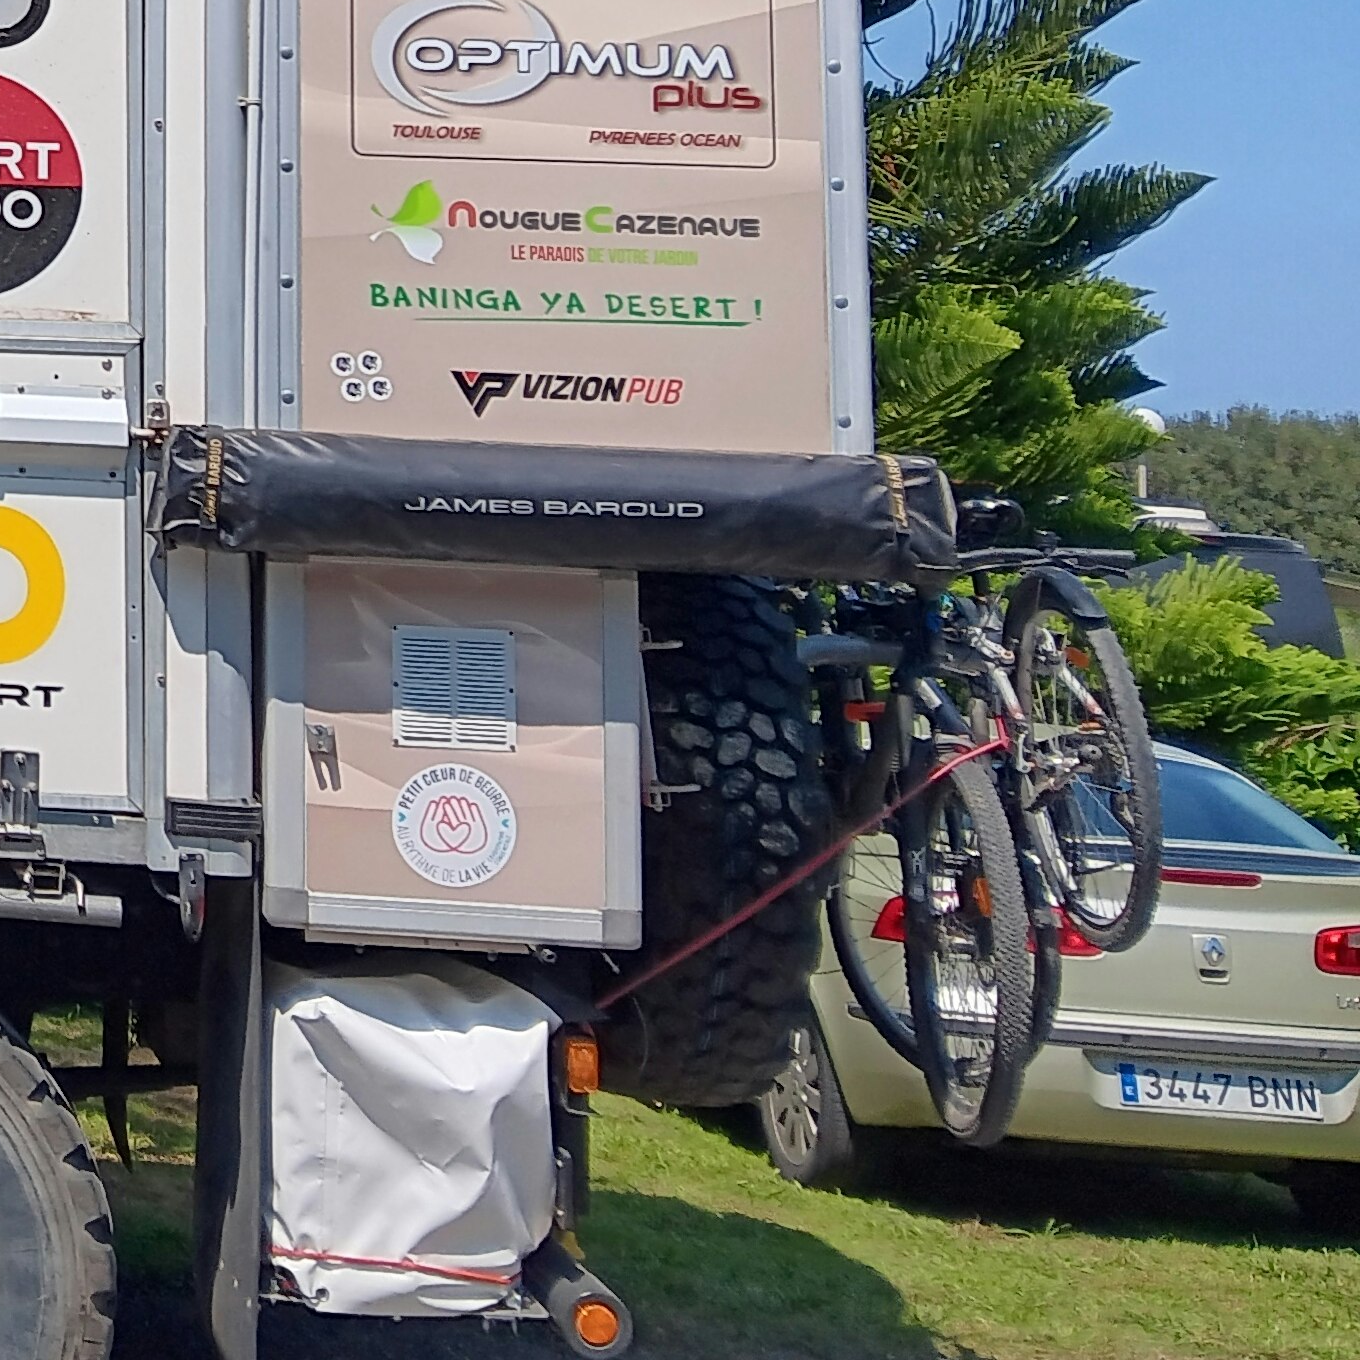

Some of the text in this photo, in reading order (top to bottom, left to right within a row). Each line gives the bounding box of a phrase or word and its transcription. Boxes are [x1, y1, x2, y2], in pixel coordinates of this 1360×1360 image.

[405, 38, 735, 80] OPTIMUM
[652, 80, 761, 113] plus
[392, 124, 481, 140] TOULOUSE
[588, 130, 742, 148] PYRENEES OCEAN
[511, 244, 526, 260] LE
[529, 245, 585, 263] PARADIS
[588, 247, 604, 262] DE
[609, 248, 649, 264] VOTRE
[370, 283, 763, 321] BANINGA YA DESERT !
[404, 496, 704, 517] JAMES BAROUD
[398, 779, 424, 810] PETIT
[459, 768, 475, 785] DE
[474, 776, 510, 816] BEURRE
[402, 839, 441, 879] RYTHME
[442, 868, 455, 883] DE
[458, 870, 472, 882] LA
[472, 861, 493, 880] VIE
[1143, 1068, 1231, 1105] 3447
[1248, 1075, 1318, 1112] BNN
